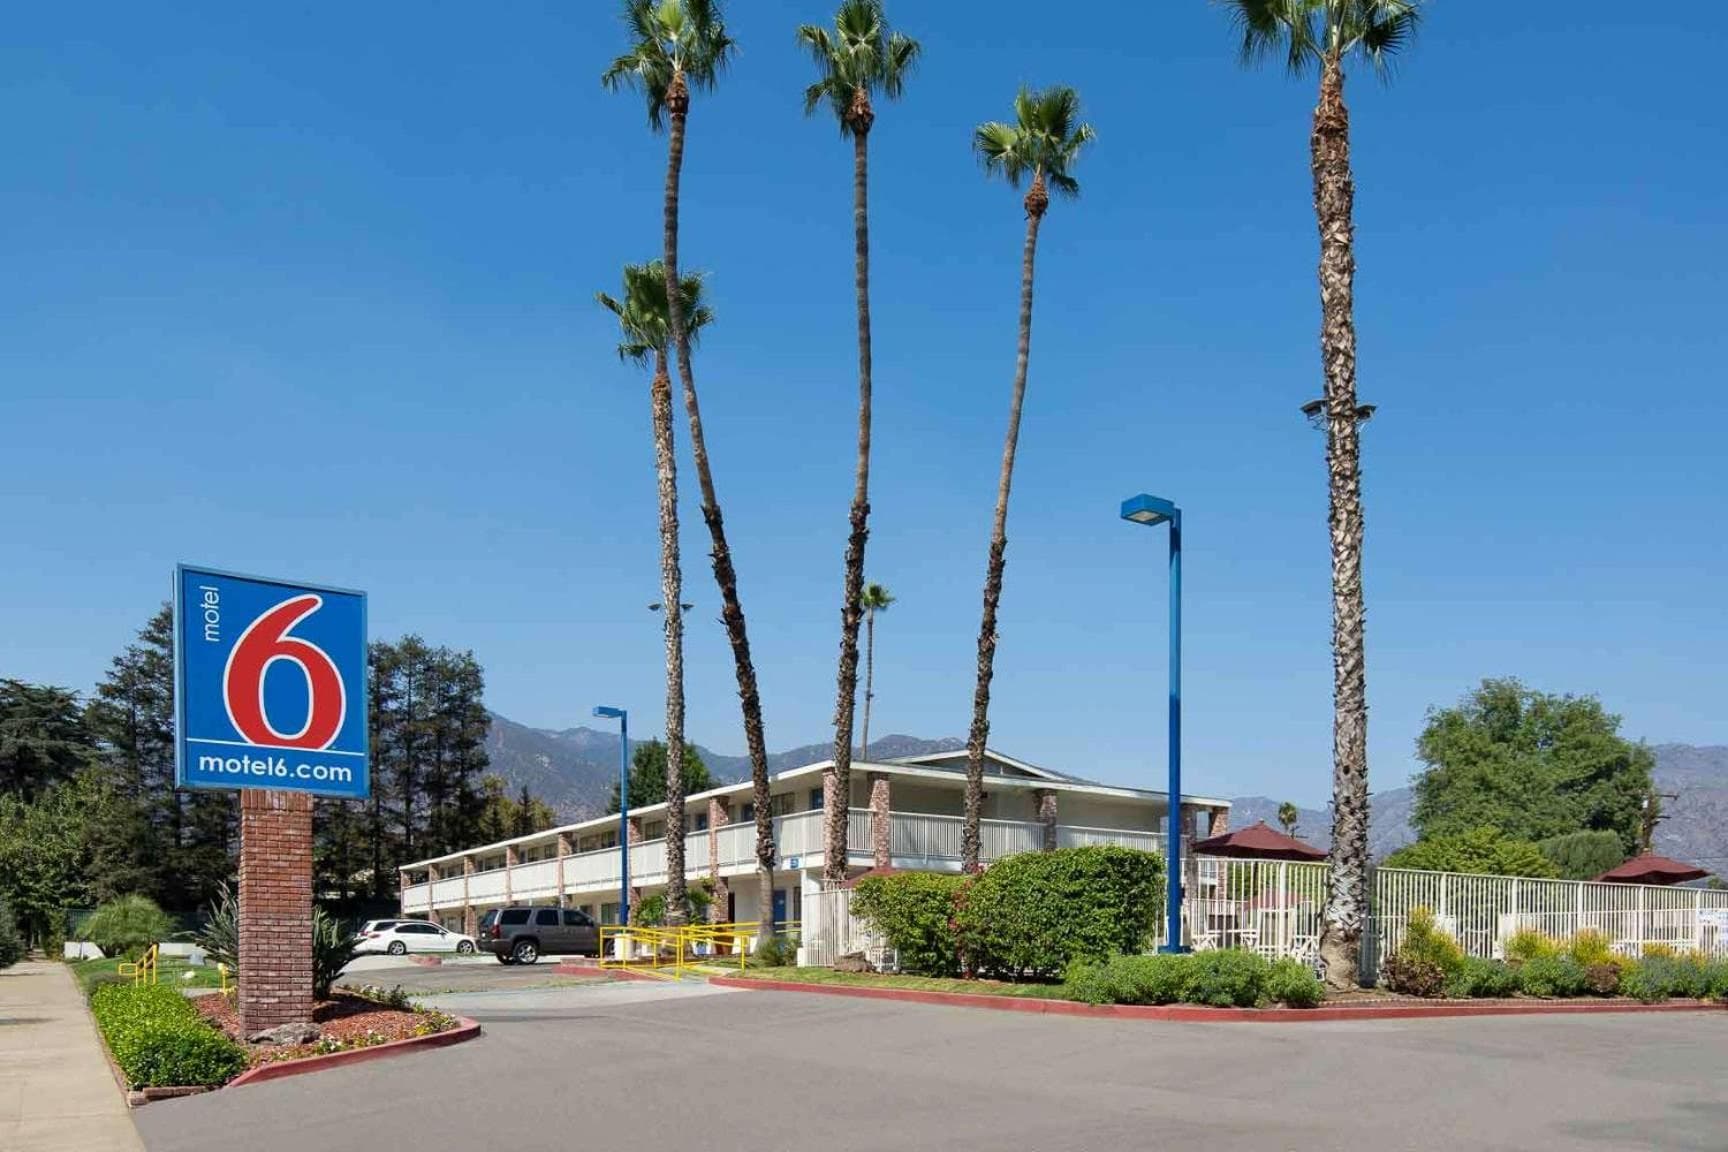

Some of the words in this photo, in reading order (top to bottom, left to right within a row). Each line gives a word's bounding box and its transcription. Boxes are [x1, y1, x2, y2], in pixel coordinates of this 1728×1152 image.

[200, 585, 219, 642] motel
[223, 594, 346, 750] 6
[199, 755, 352, 782] motel6.com
